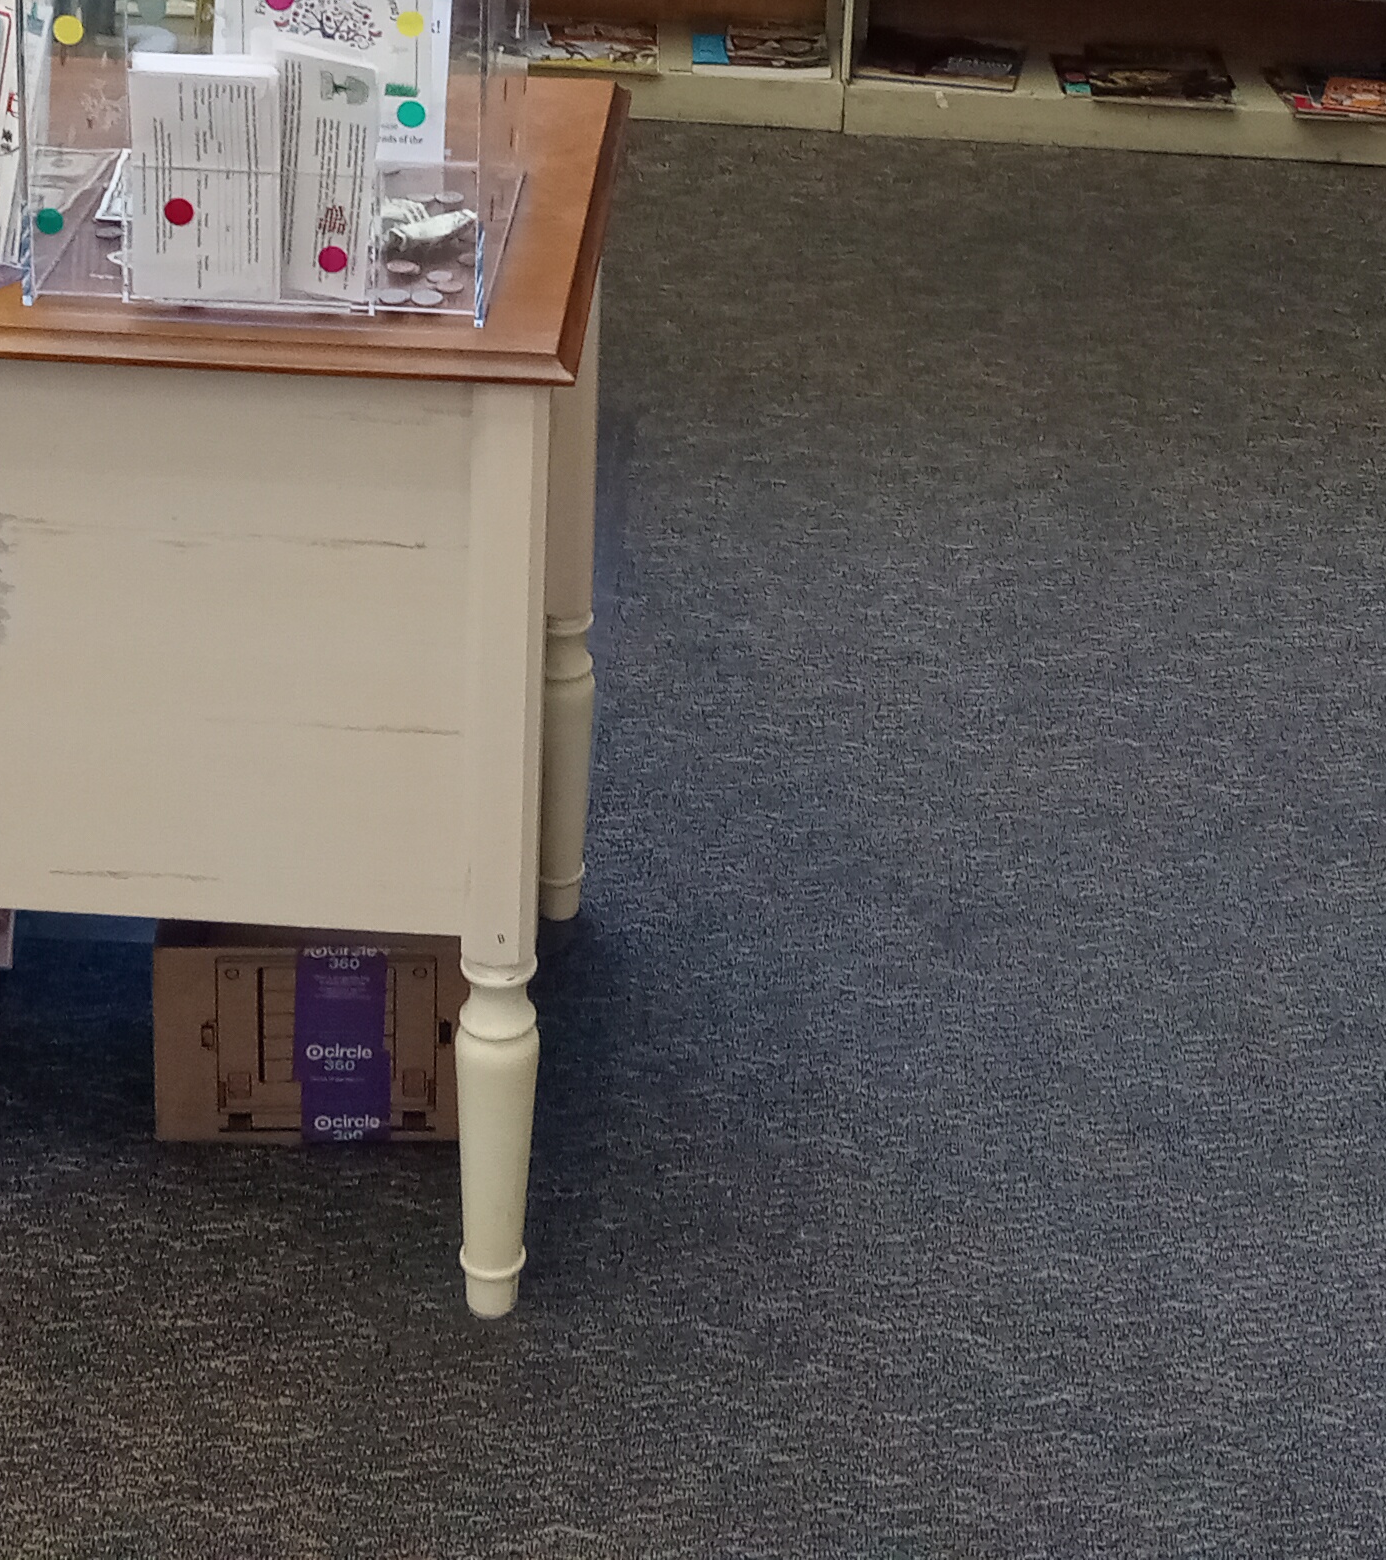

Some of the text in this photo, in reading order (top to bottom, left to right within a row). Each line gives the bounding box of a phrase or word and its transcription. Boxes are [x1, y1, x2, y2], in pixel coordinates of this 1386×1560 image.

[324, 1042, 374, 1061] circle
[323, 1059, 356, 1072] 360
[331, 1113, 381, 1130] circle
